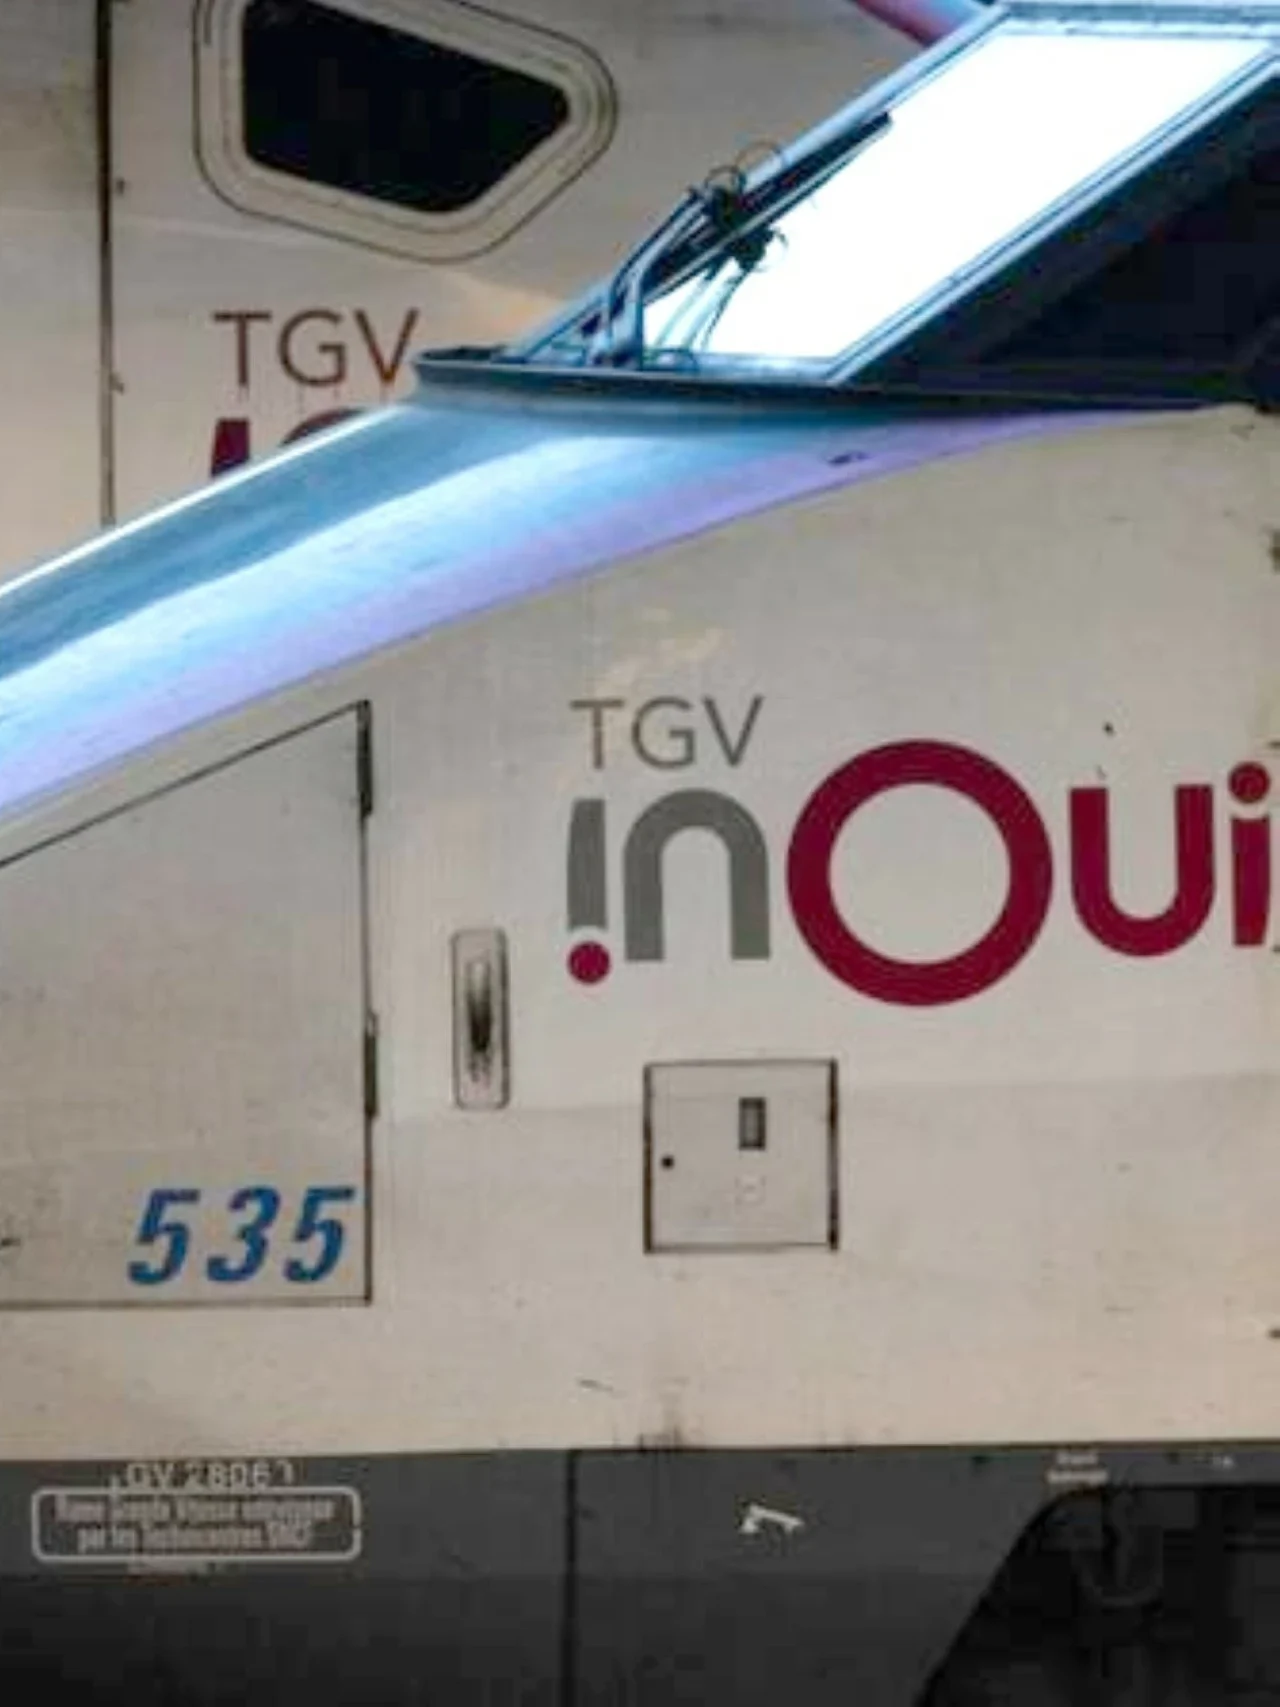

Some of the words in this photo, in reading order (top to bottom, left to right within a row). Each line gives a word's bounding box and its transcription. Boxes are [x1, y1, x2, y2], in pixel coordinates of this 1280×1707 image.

[214, 308, 419, 387] TGV
[570, 695, 764, 770] TGV
[127, 1185, 357, 1285] 535
